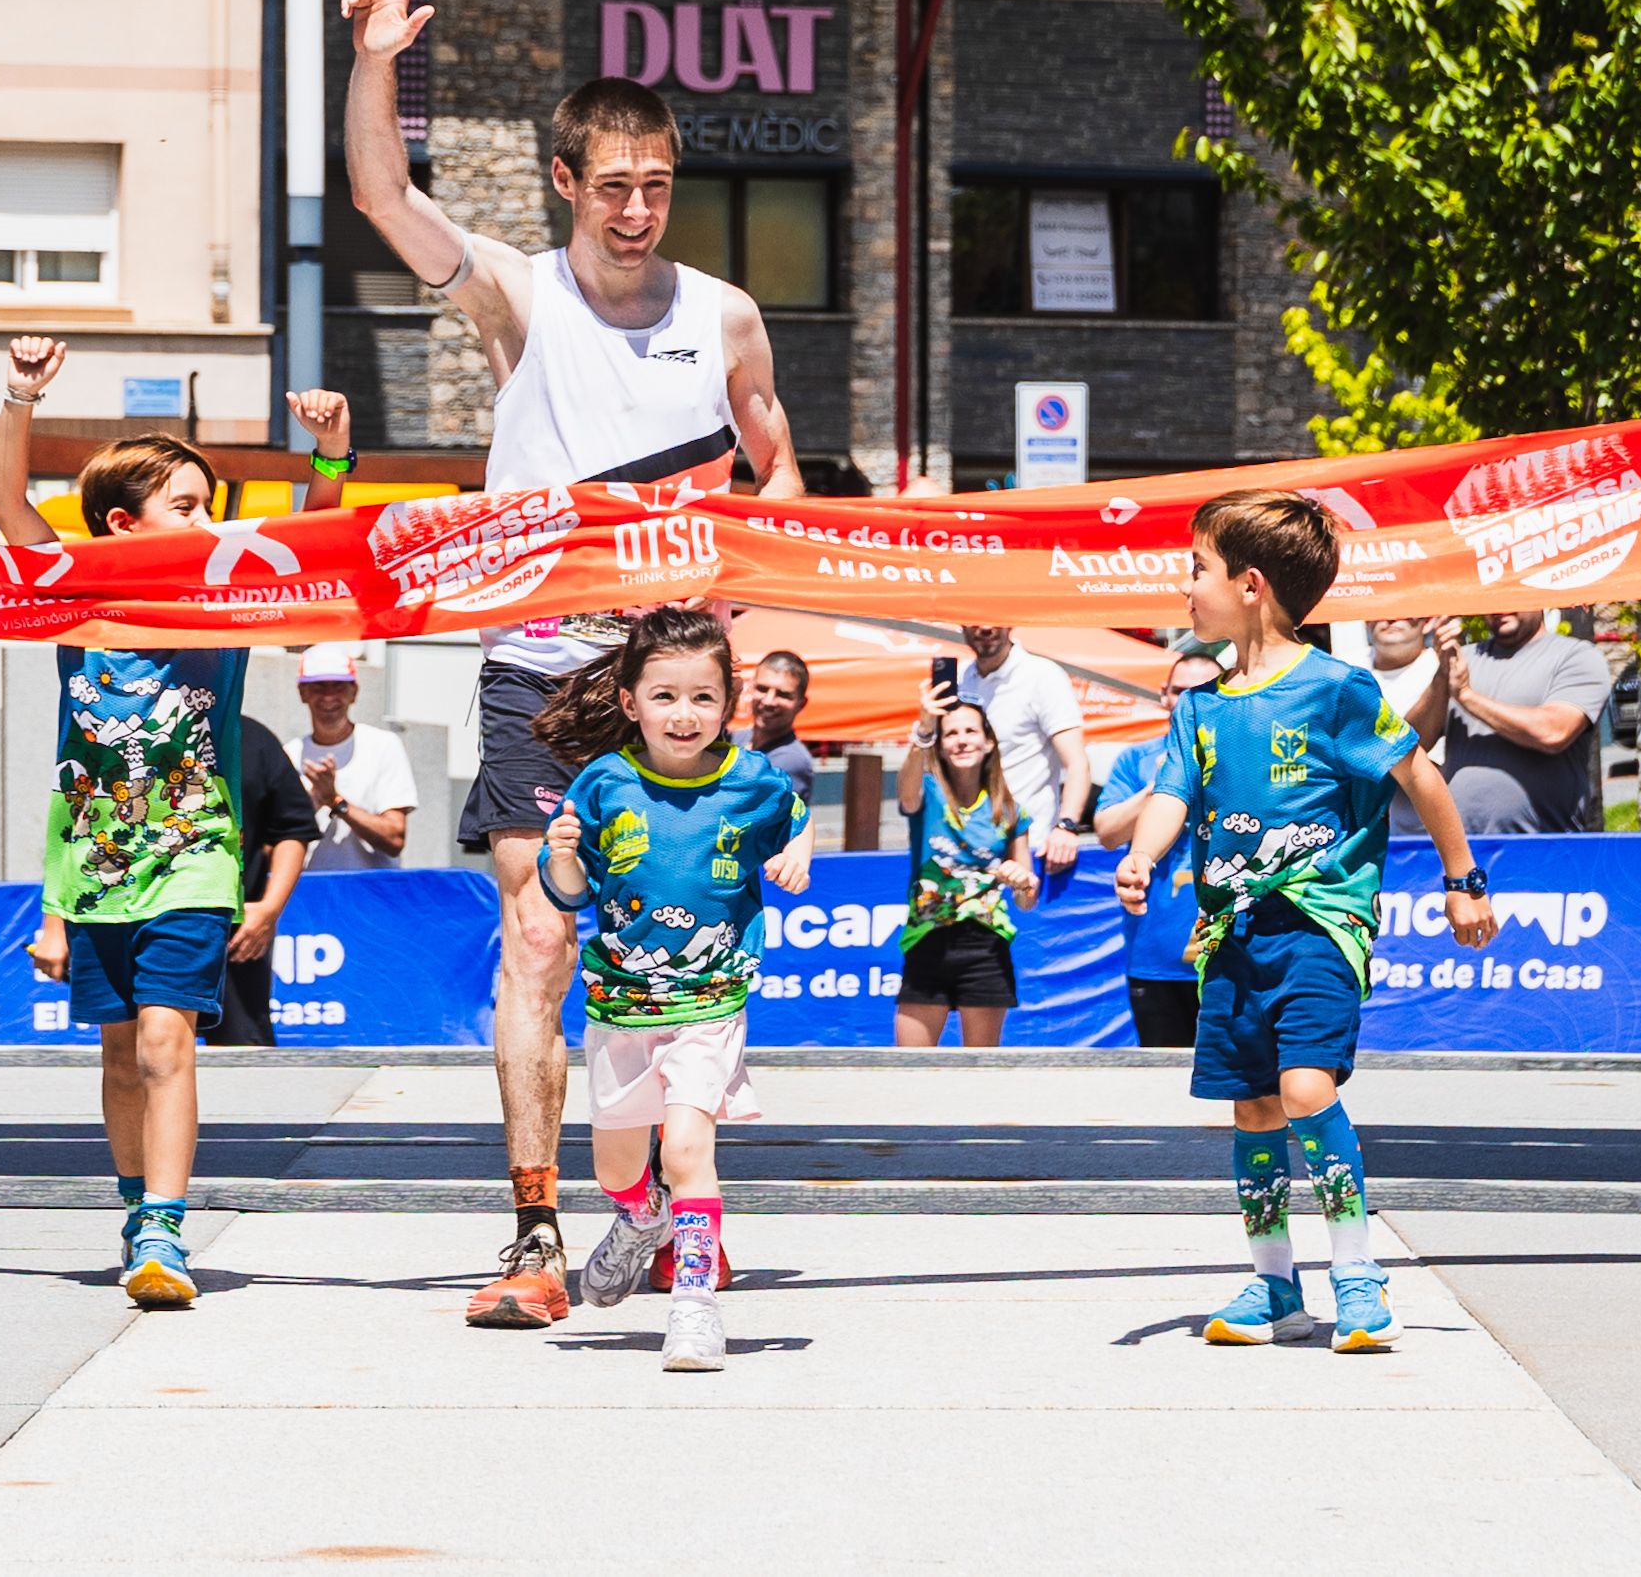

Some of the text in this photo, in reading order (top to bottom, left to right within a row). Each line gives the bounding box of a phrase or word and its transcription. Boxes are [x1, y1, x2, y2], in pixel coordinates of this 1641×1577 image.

[600, 0, 836, 94] DUAT
[388, 485, 575, 594] TRAVESSA
[613, 515, 720, 570] OTSO
[924, 530, 1006, 555] Casa
[1340, 539, 1428, 565] VALIRA
[394, 510, 581, 610] D'ENCAMP
[618, 564, 721, 587] THINK SPORT
[1047, 544, 1194, 578] Andorr
[1549, 545, 1621, 585] ANDORRA
[464, 562, 545, 606] ANDORRA
[1325, 585, 1375, 598] NDORRA
[230, 609, 287, 623] ANDORRA
[1269, 762, 1308, 784] OTSO
[711, 857, 740, 880] OTSO
[1377, 891, 1609, 947] ncmp
[809, 968, 861, 999] de
[868, 965, 903, 997] la
[1429, 957, 1475, 989] de
[1480, 956, 1513, 989] la
[1518, 957, 1603, 991] Casa
[33, 1000, 69, 1031] El
